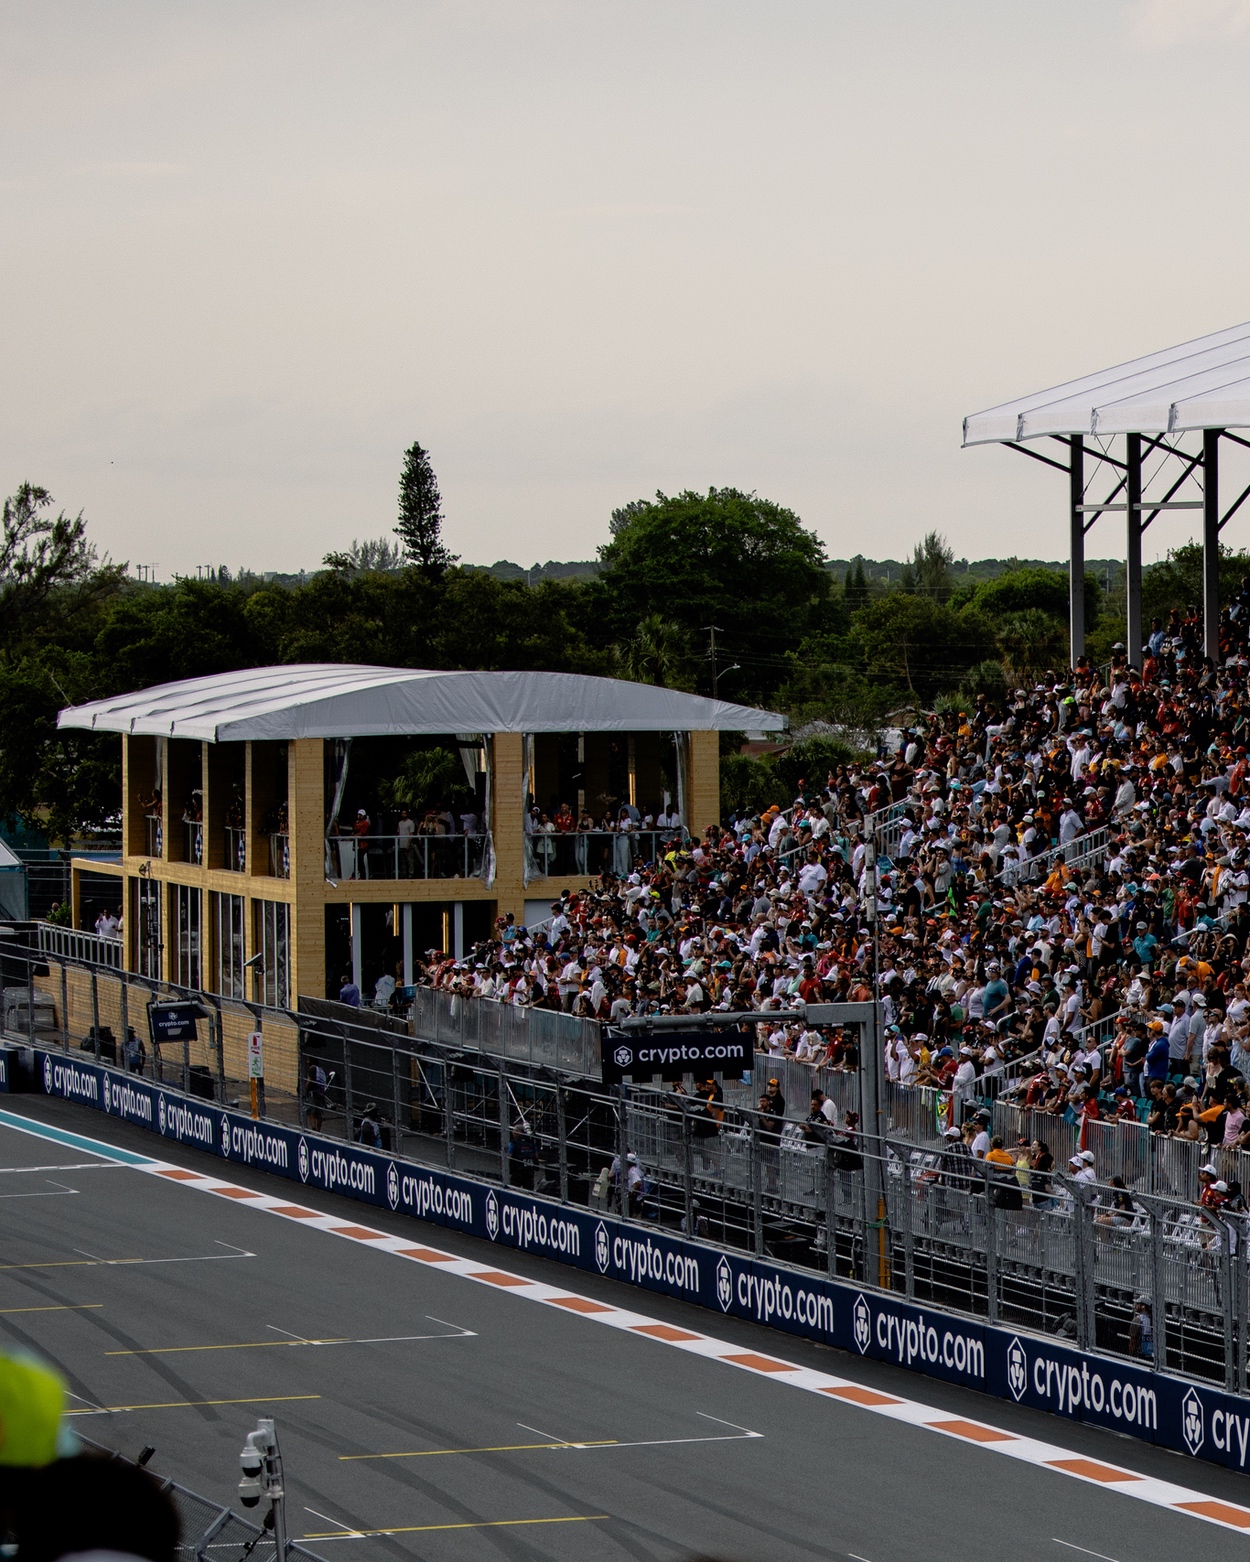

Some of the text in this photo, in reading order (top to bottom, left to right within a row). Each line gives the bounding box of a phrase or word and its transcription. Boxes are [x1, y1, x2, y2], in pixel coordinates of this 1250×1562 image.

[158, 1020, 190, 1028] crypto.com
[638, 1044, 744, 1063] crypto.com
[53, 1063, 98, 1101] crypto.com
[111, 1082, 152, 1122] crypto.com
[167, 1102, 213, 1145] crypto.com
[232, 1125, 288, 1168] crypto.com
[311, 1148, 375, 1195] crypto.com
[402, 1175, 473, 1224] crypto.com
[502, 1204, 580, 1258] crypto.com
[614, 1235, 699, 1293] crypto.com
[738, 1274, 834, 1334] crypto.com
[877, 1311, 985, 1378] crypto.com
[1033, 1356, 1158, 1431] crypto.com
